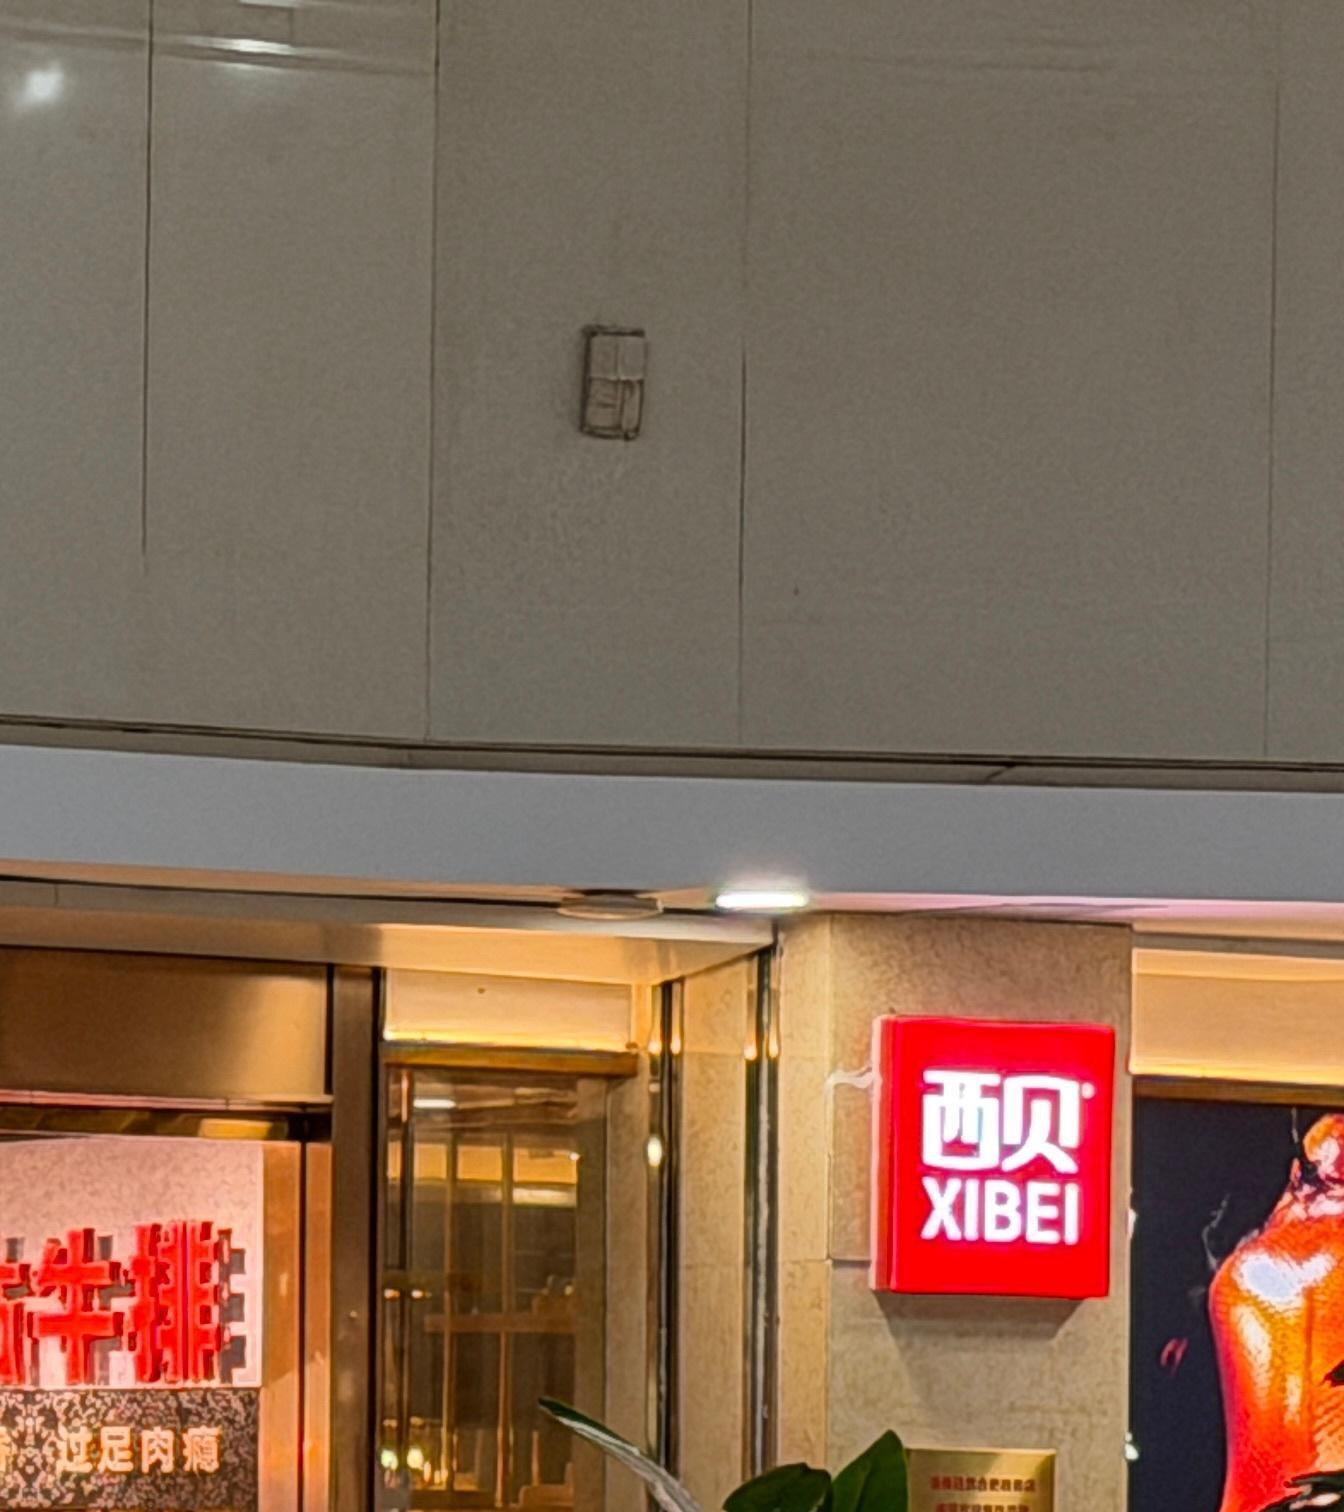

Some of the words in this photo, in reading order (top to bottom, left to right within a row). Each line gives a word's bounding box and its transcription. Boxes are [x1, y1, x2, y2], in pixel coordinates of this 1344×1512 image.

[922, 1069, 1079, 1174] 西贝
[920, 1176, 1080, 1246] XIBEI
[57, 1425, 222, 1475] 过足肉瘾
